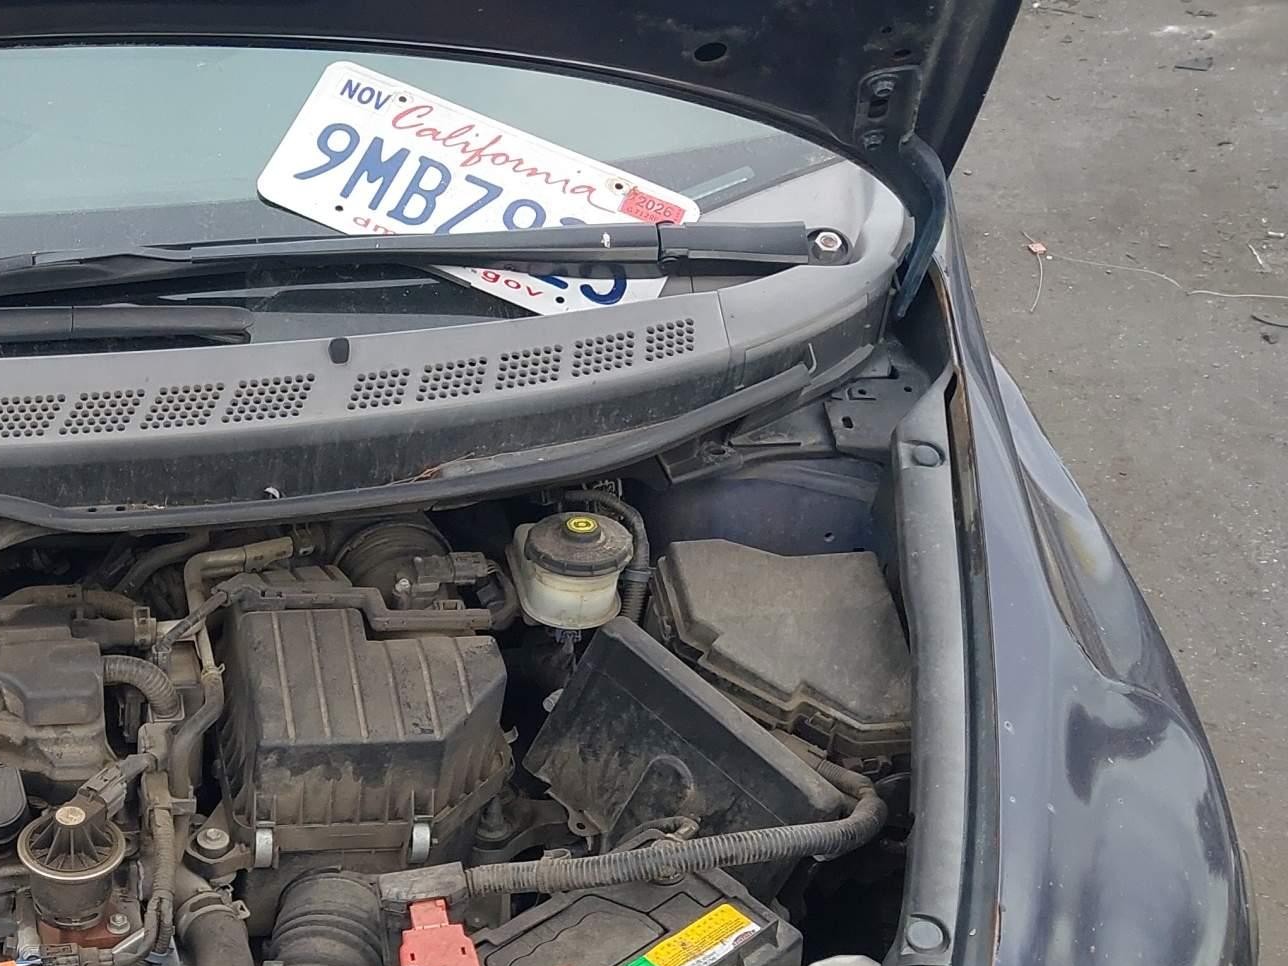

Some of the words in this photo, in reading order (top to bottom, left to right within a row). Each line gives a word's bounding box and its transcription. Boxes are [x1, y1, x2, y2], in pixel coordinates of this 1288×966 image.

[340, 79, 393, 110] NOV
[391, 105, 616, 214] California
[635, 195, 673, 218] 2026
